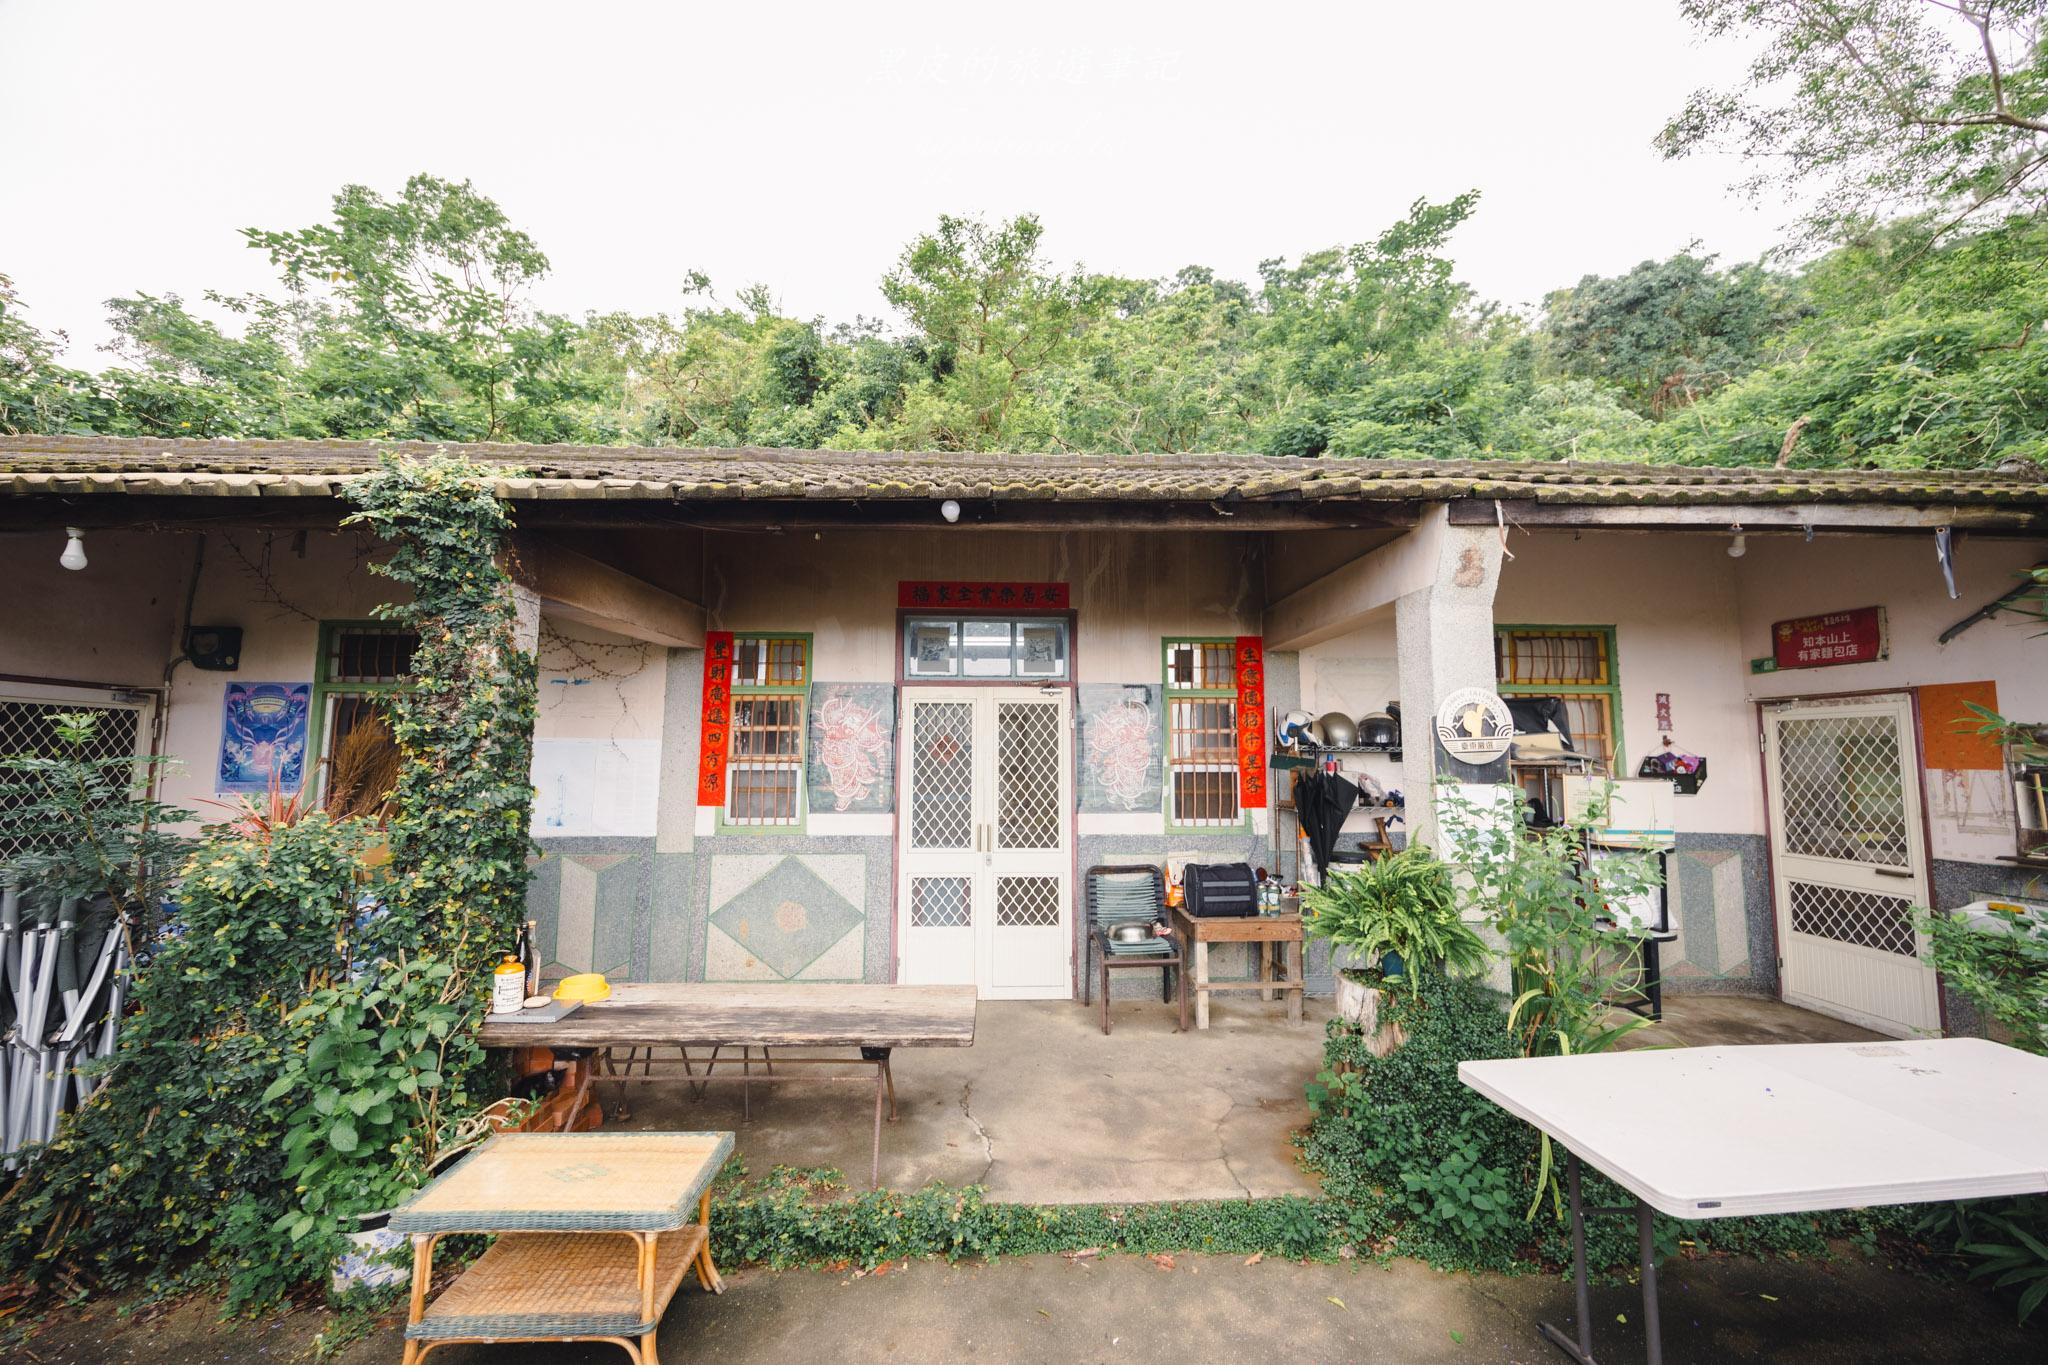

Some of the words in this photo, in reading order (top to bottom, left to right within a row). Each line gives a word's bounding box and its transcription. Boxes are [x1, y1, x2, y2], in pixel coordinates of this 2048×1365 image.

[1802, 632, 1851, 648] 知本山上
[1797, 644, 1858, 661] 有家麵包店
[1241, 647, 1263, 794] 生意遠招千里客
